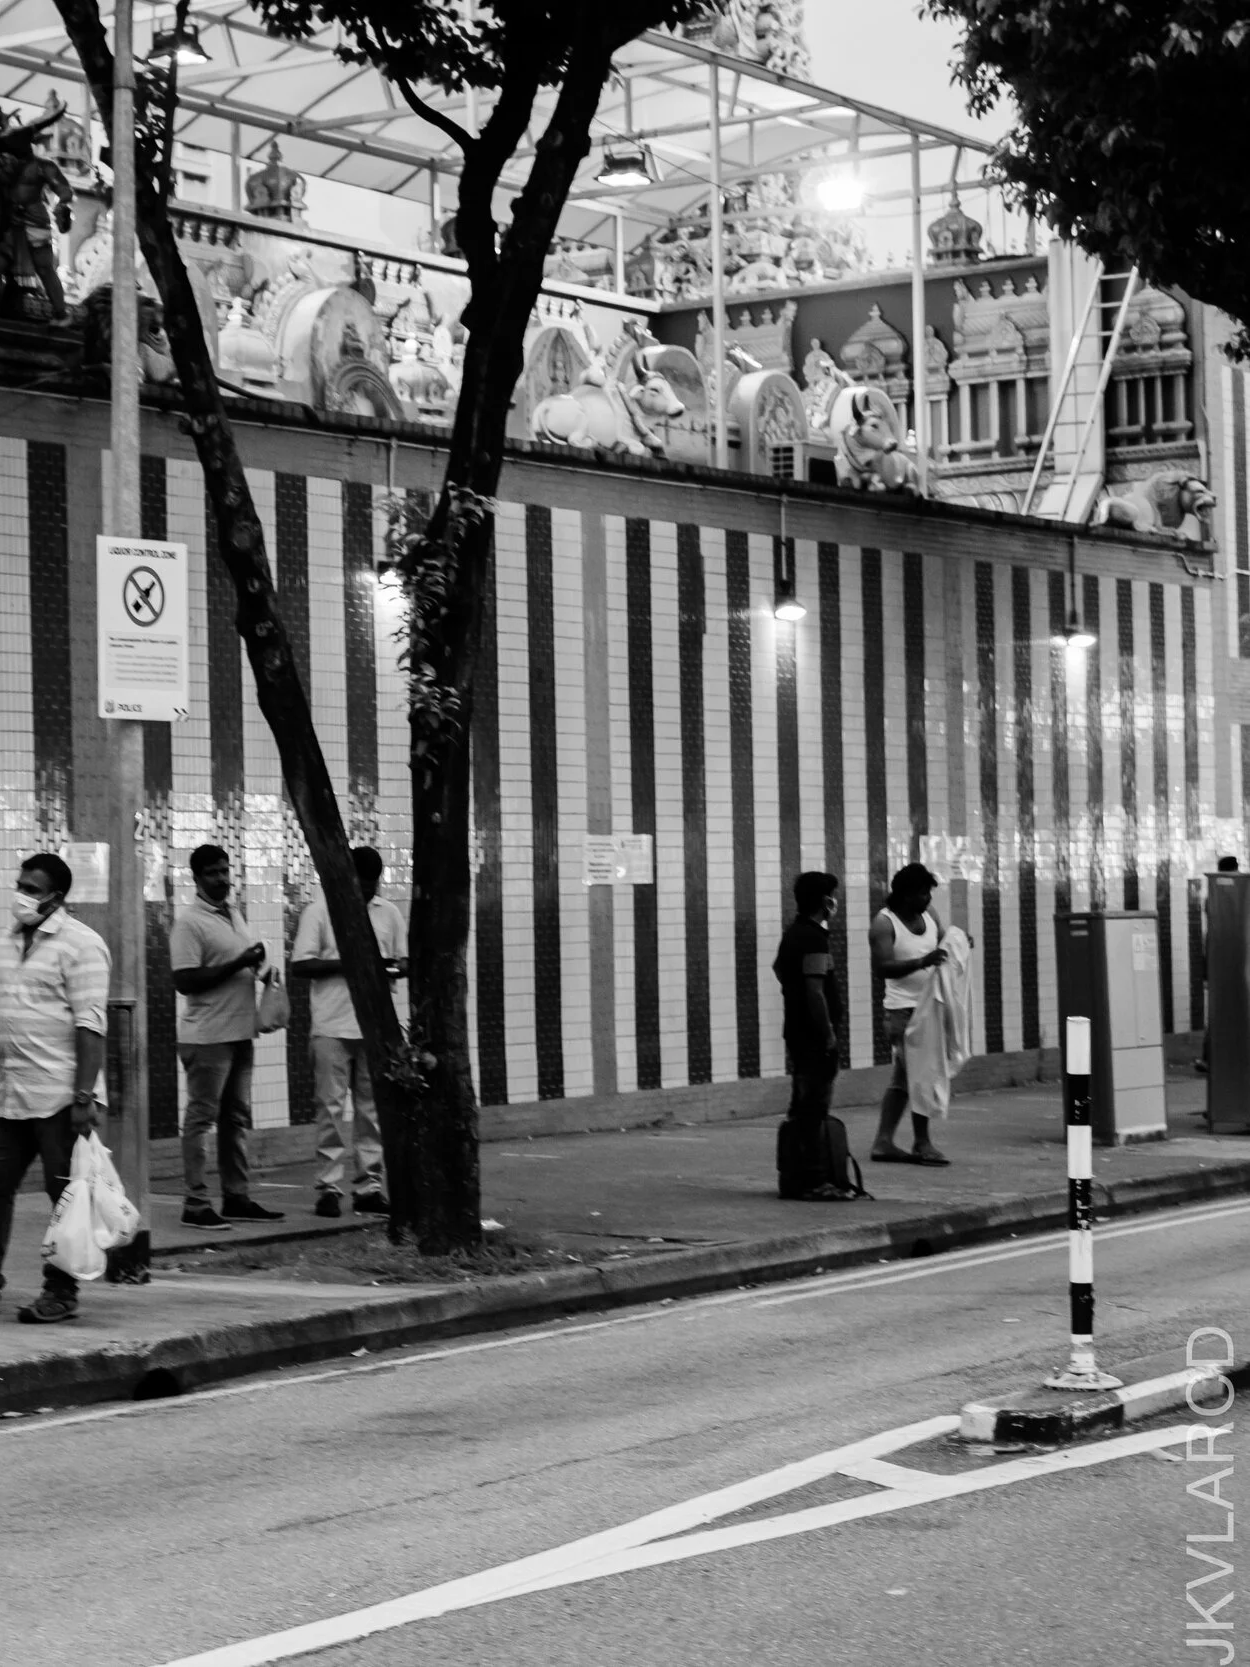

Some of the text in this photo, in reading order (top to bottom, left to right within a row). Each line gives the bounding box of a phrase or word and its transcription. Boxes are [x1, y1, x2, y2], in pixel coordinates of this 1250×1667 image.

[132, 547, 160, 559] CONTROL
[161, 549, 178, 560] ZONE
[118, 703, 143, 713] POLICE
